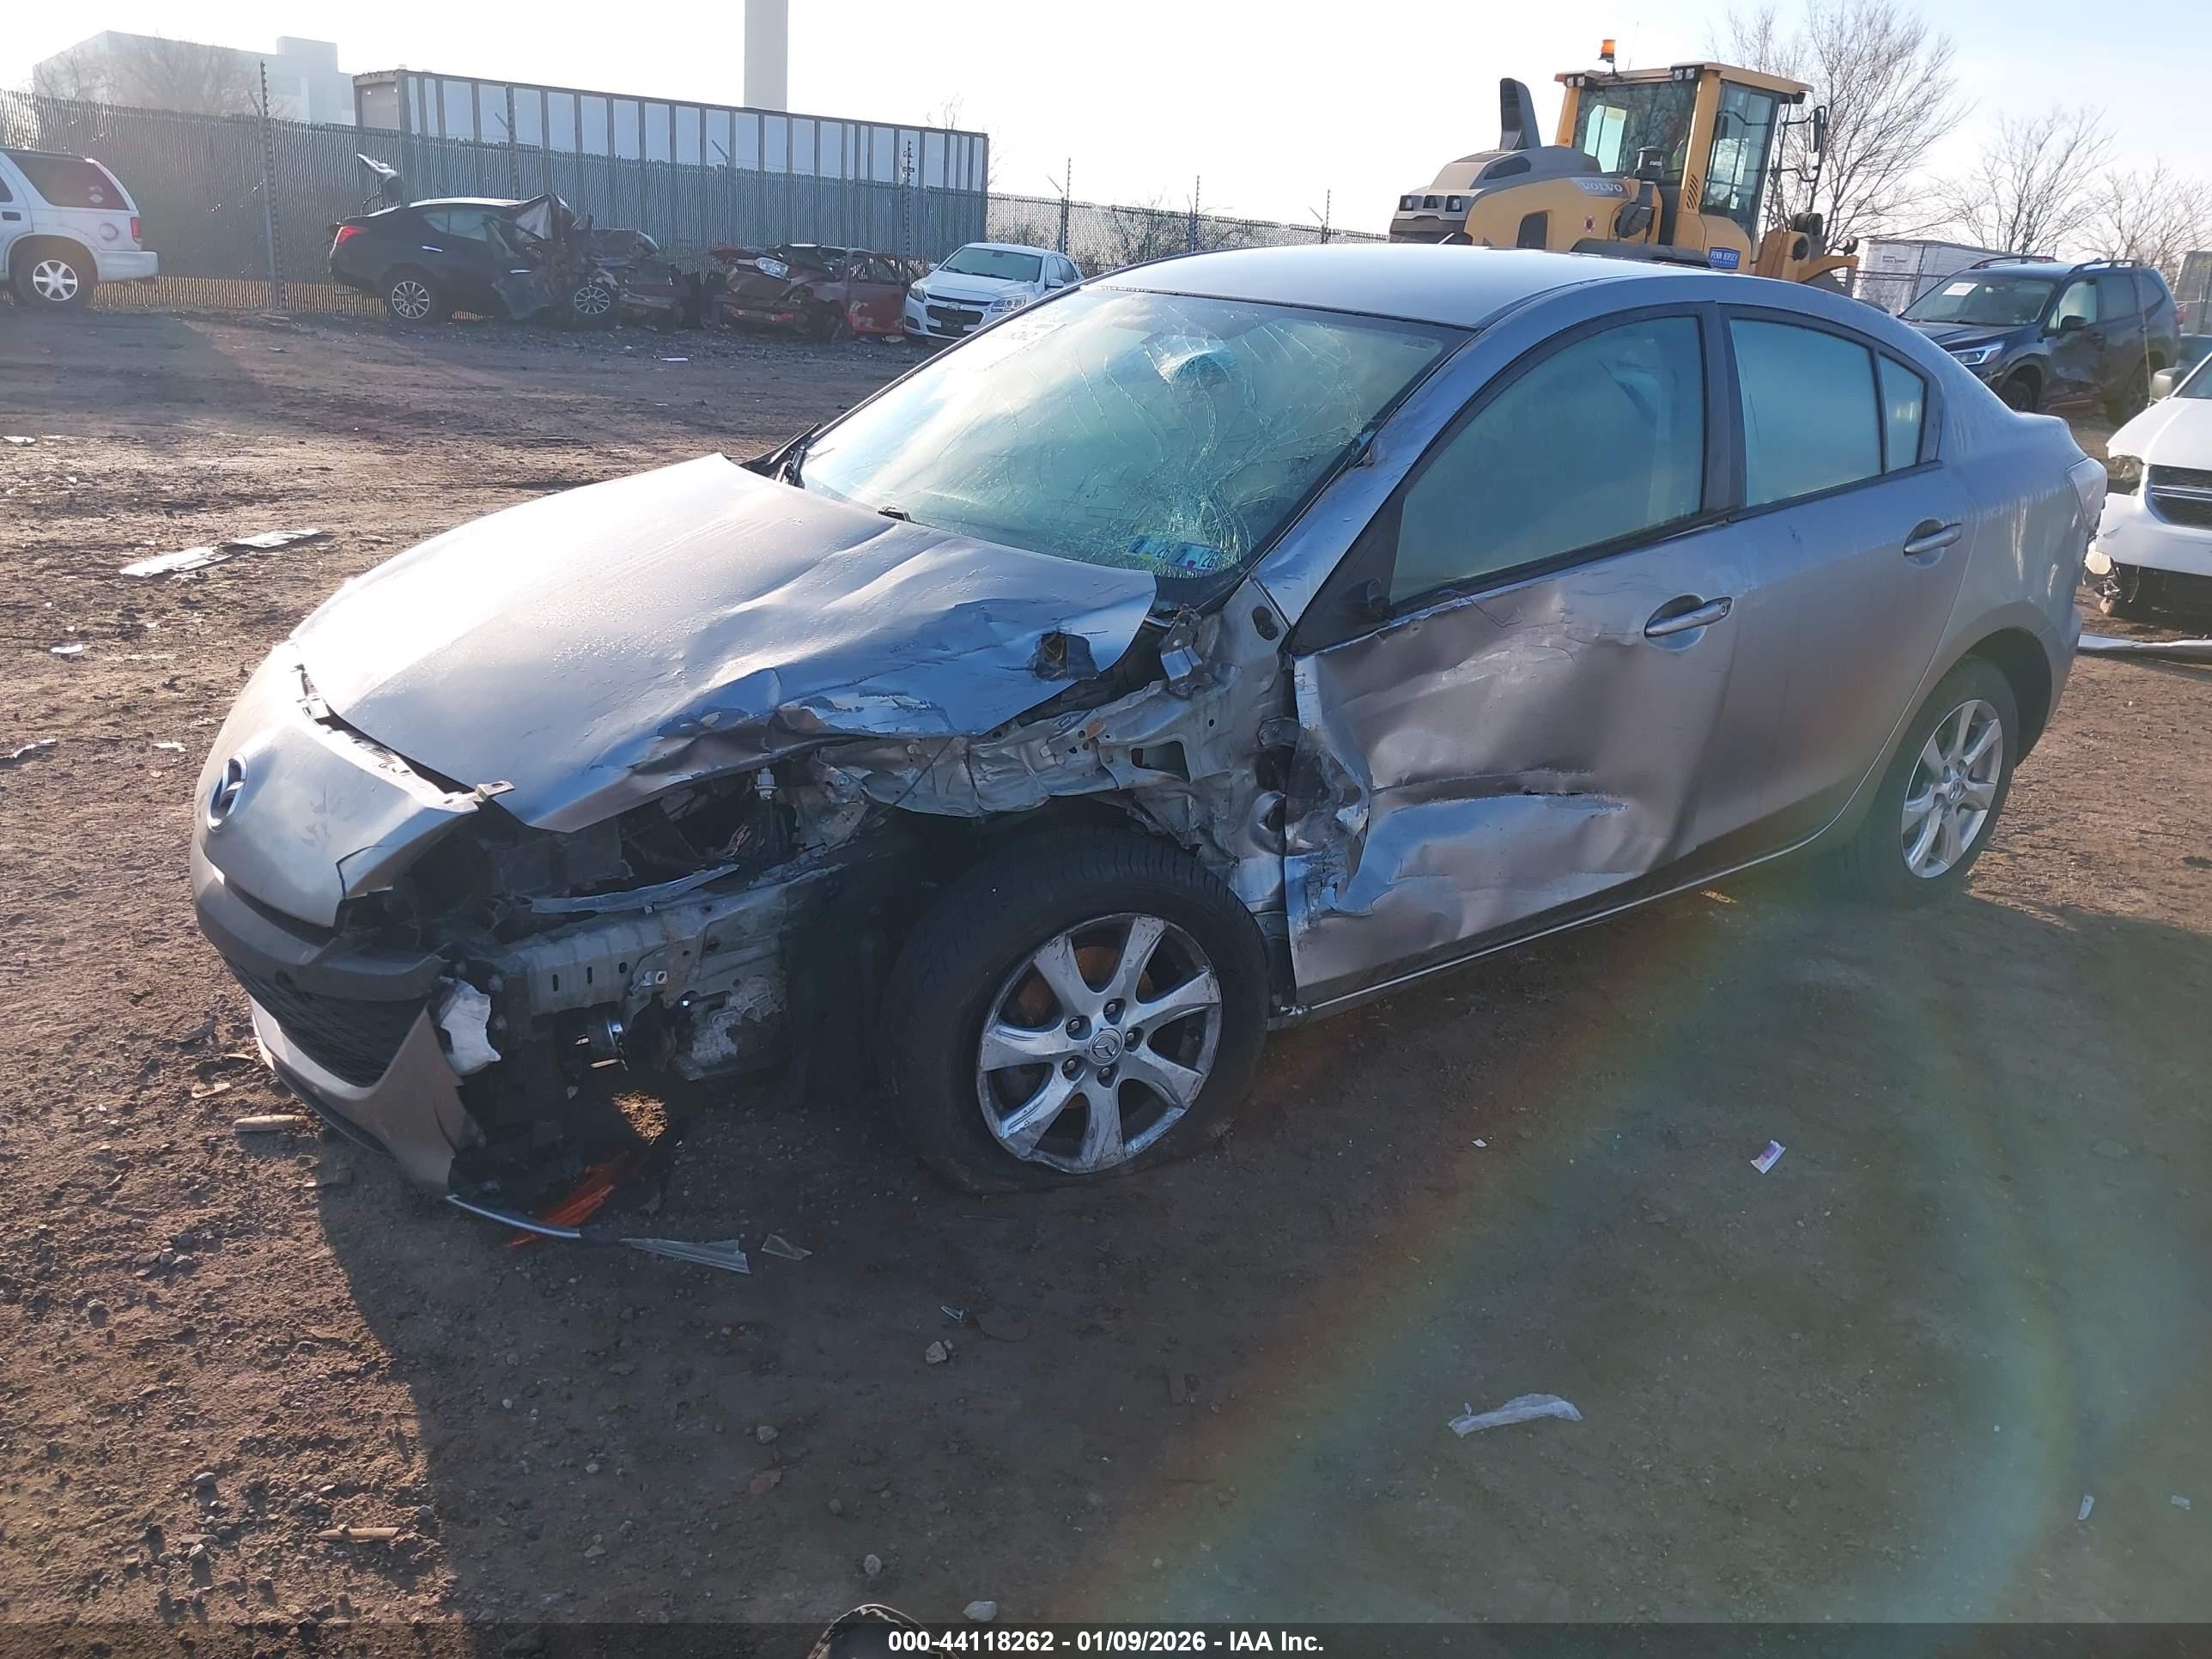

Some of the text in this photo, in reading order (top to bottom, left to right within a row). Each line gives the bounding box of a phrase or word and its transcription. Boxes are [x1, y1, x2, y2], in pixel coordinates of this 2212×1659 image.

[1582, 182, 1623, 192] VOLVO
[1711, 251, 1738, 262] PENN JERSEY
[1201, 550, 1219, 568] 26
